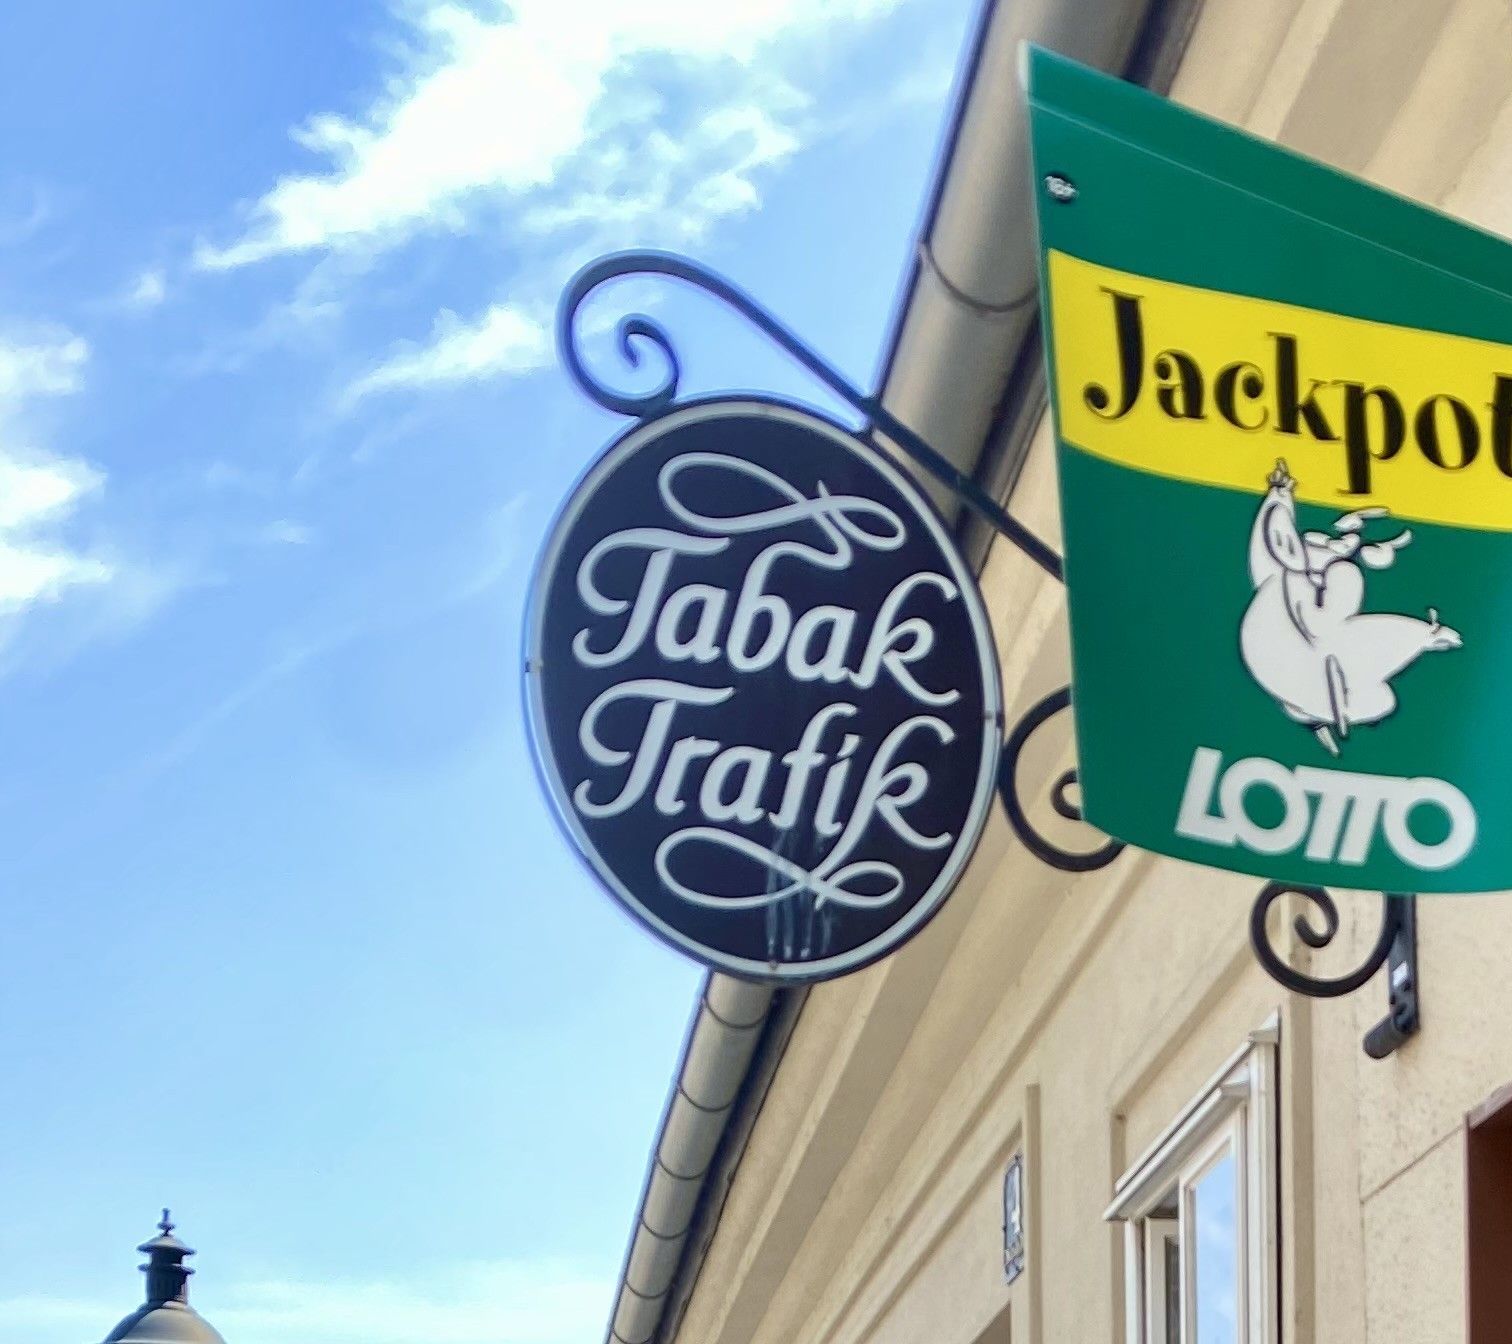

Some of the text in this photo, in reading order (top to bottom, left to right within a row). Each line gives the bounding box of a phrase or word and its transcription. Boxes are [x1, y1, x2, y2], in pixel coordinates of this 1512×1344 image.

[573, 481, 960, 705] Tabak
[574, 679, 955, 878] Trafik
[1176, 747, 1478, 870] LOTTO
